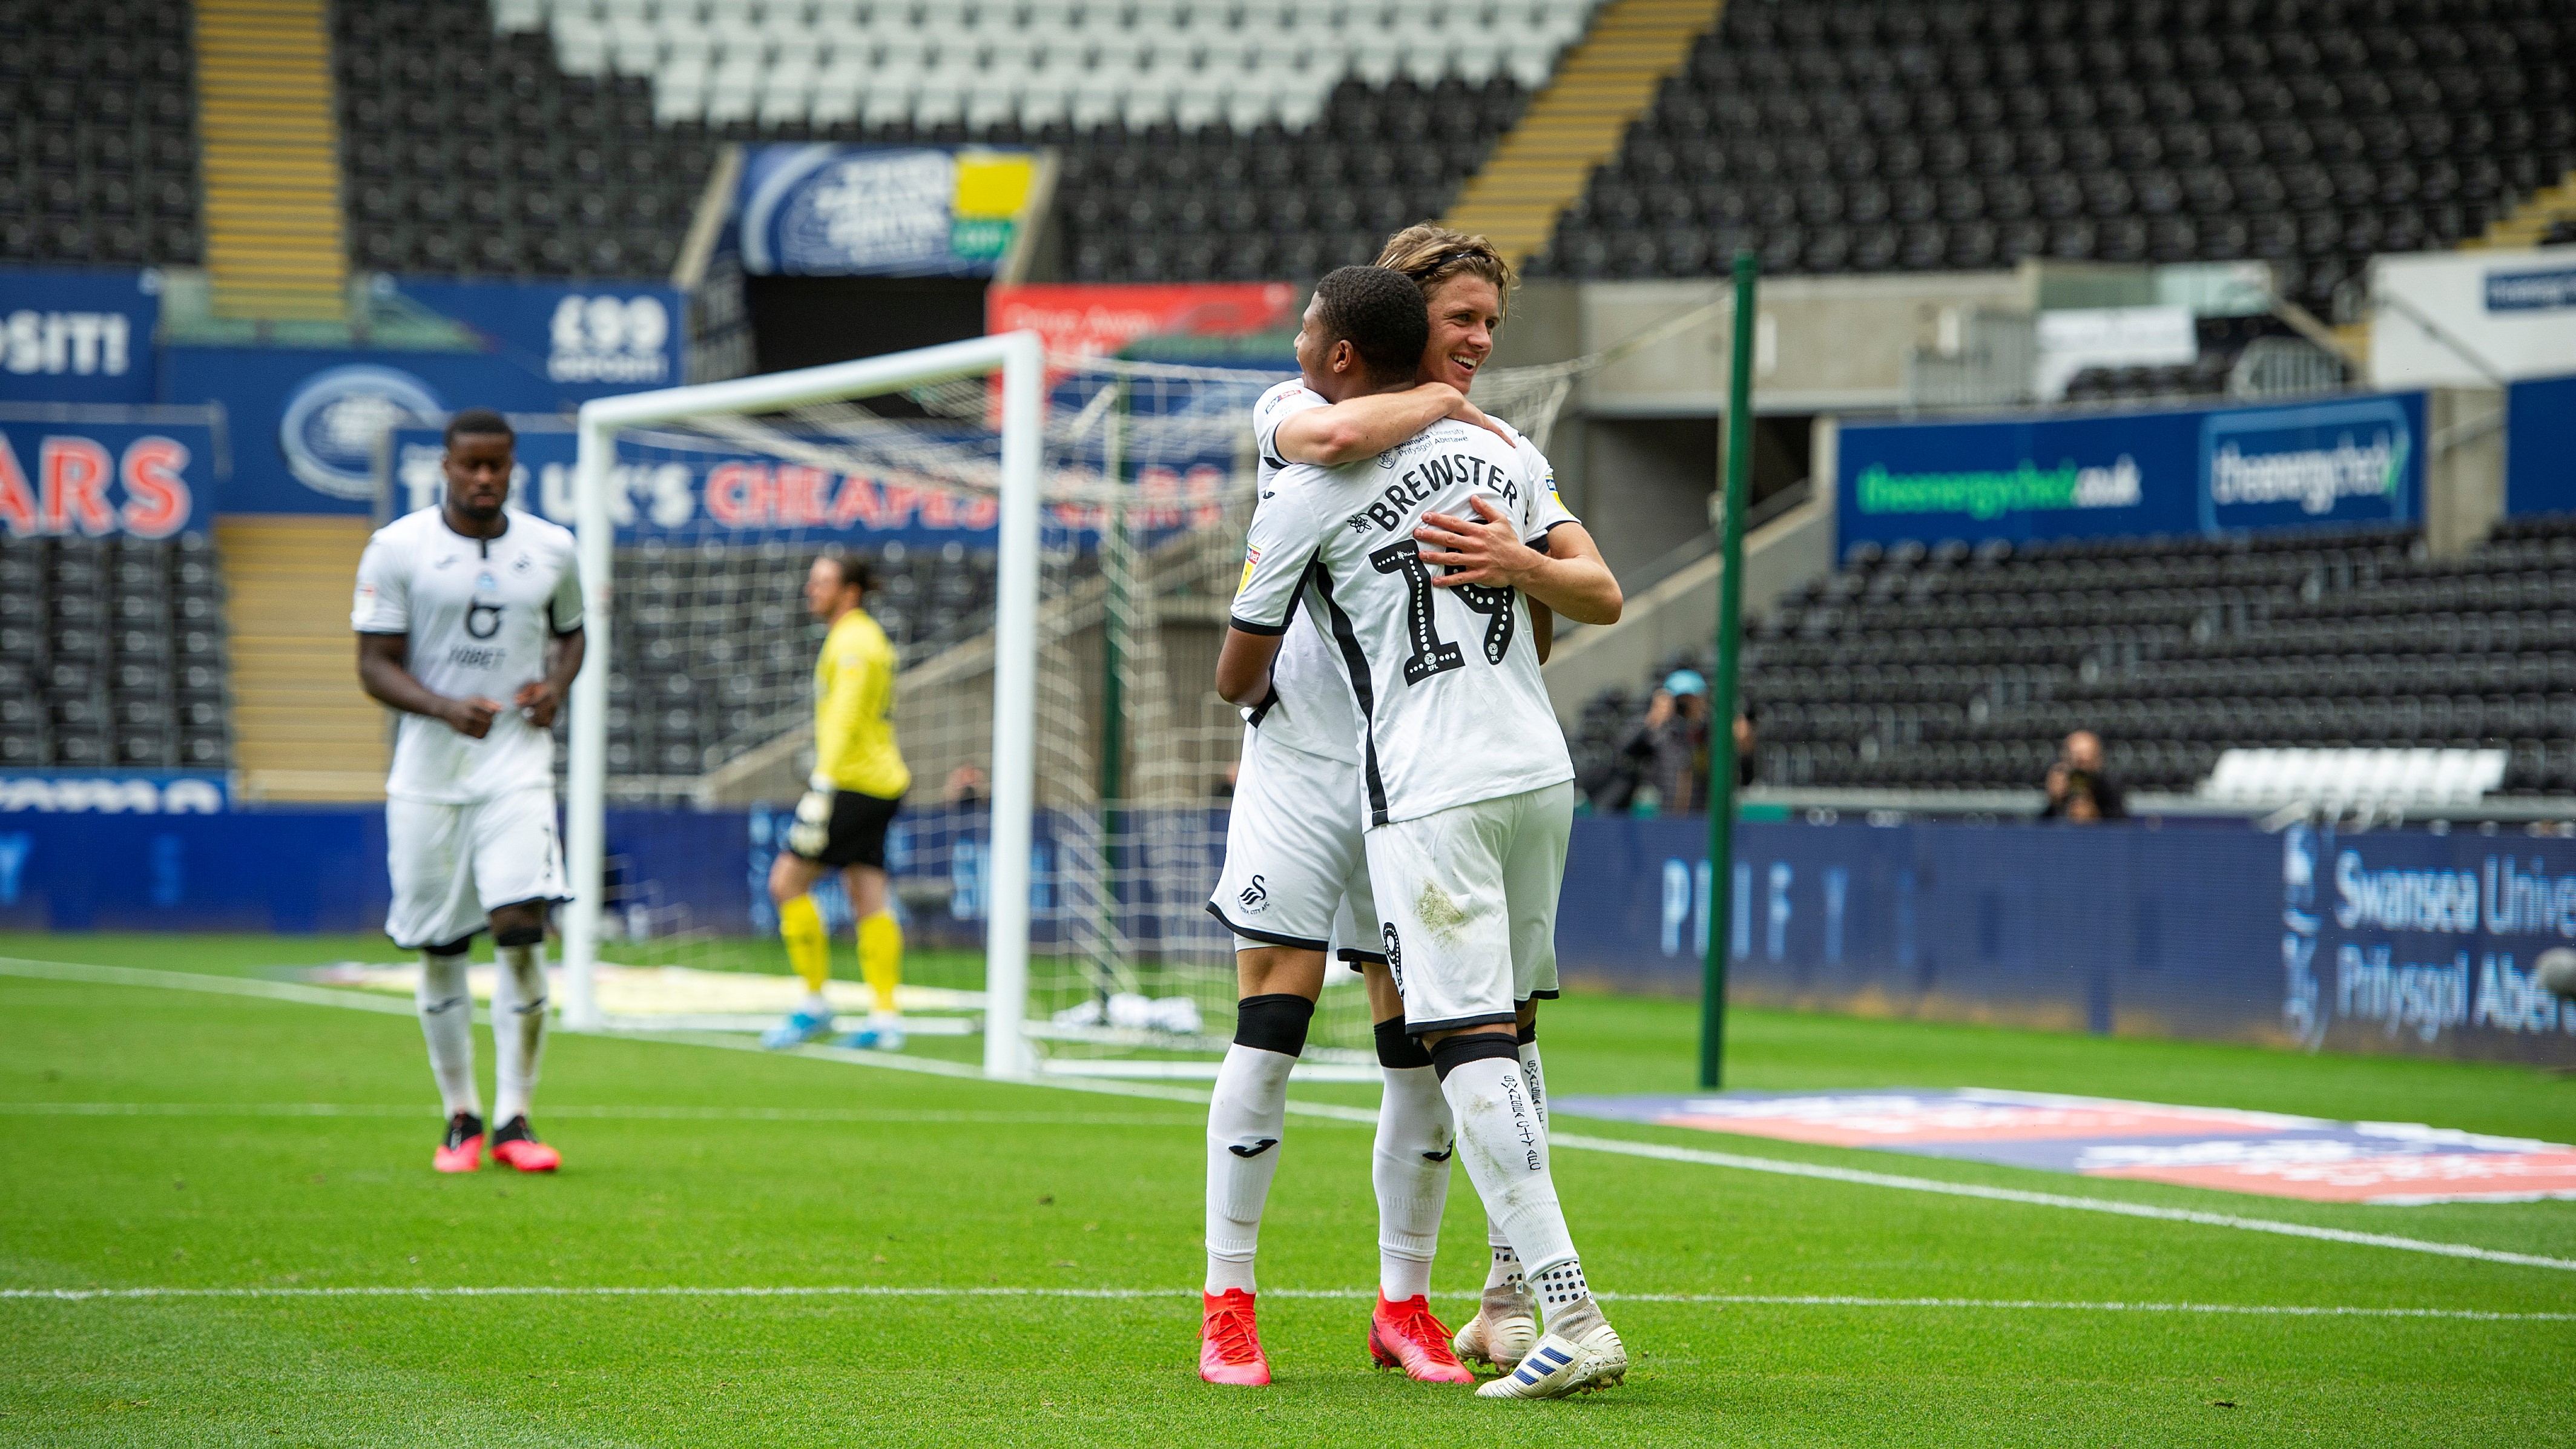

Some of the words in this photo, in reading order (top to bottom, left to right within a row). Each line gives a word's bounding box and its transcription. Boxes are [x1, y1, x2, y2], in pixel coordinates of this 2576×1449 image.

[0, 309, 129, 376] SIT!
[1434, 435, 1469, 445] Abertawe
[1368, 454, 1518, 532] BREWSTER
[1368, 520, 1516, 687] 19
[1428, 663, 1439, 672] EFL
[2334, 849, 2479, 933] Swansea
[1501, 1075, 1525, 1118] SWANSEA
[1526, 1149, 1541, 1171] AFC
